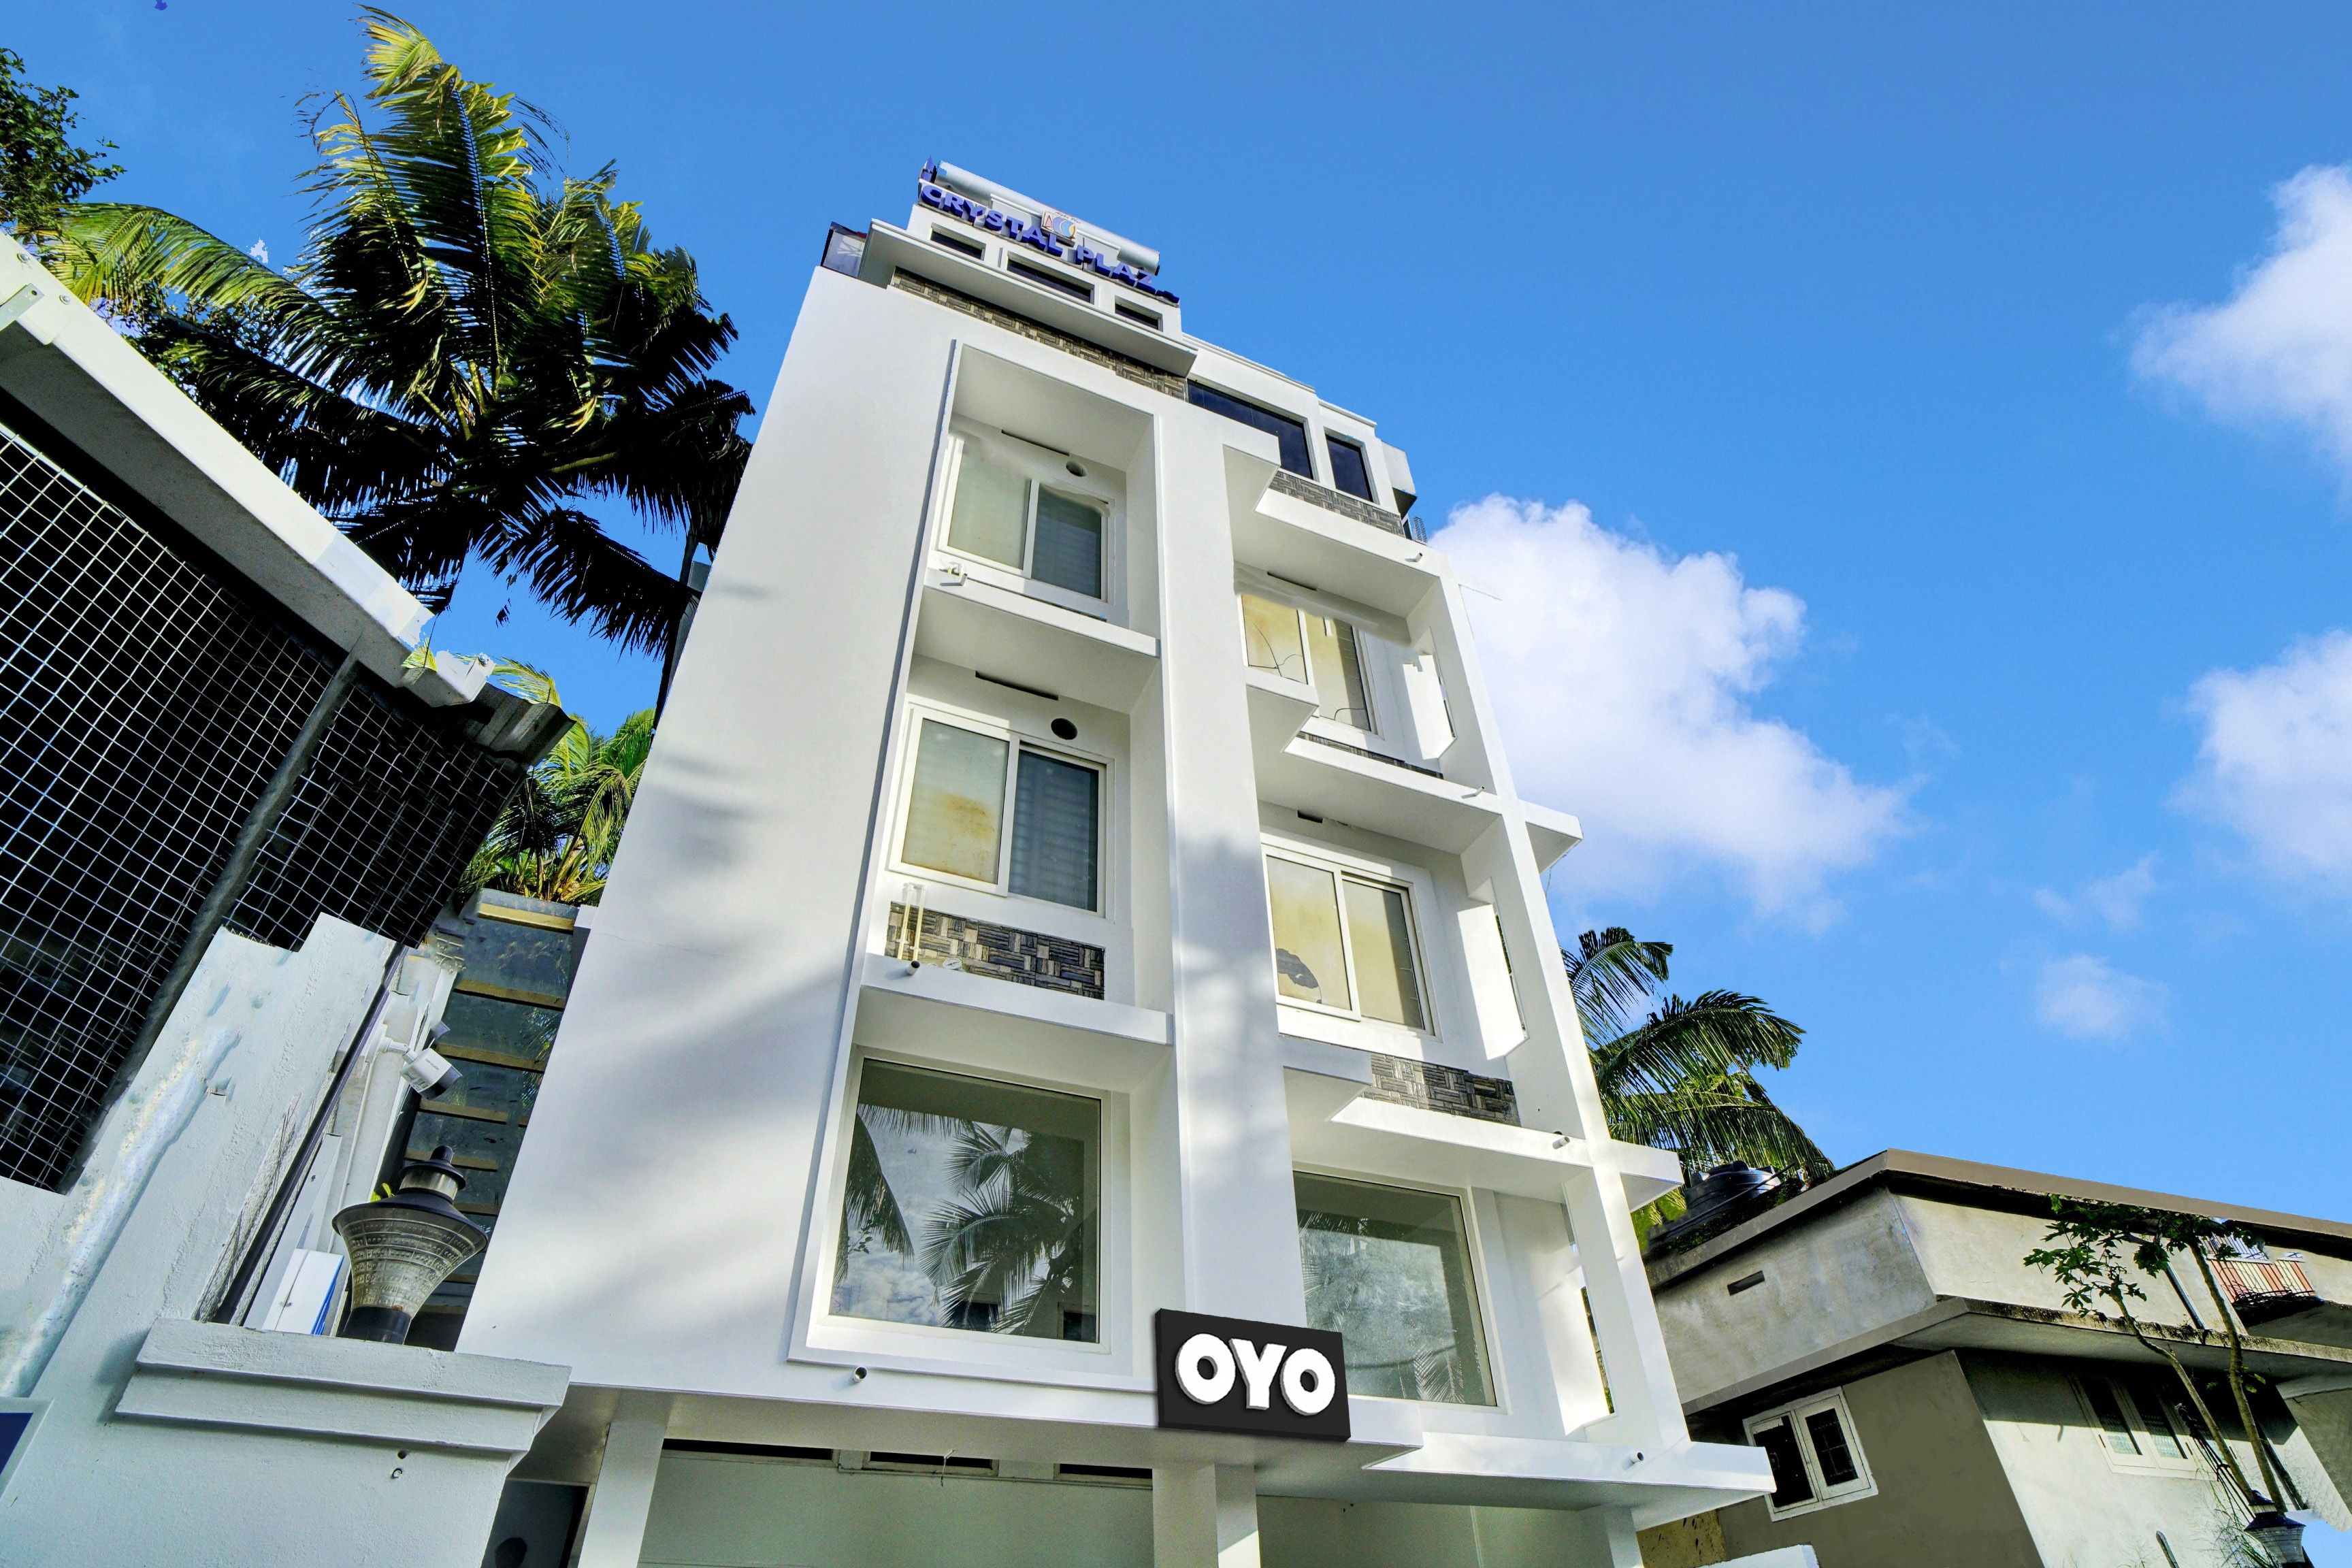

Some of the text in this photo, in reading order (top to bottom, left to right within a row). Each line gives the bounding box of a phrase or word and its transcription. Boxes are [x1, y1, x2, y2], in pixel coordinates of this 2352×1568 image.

[921, 184, 1180, 304] CRYSTAL PLAZ
[1175, 1333, 1336, 1416] OYO
